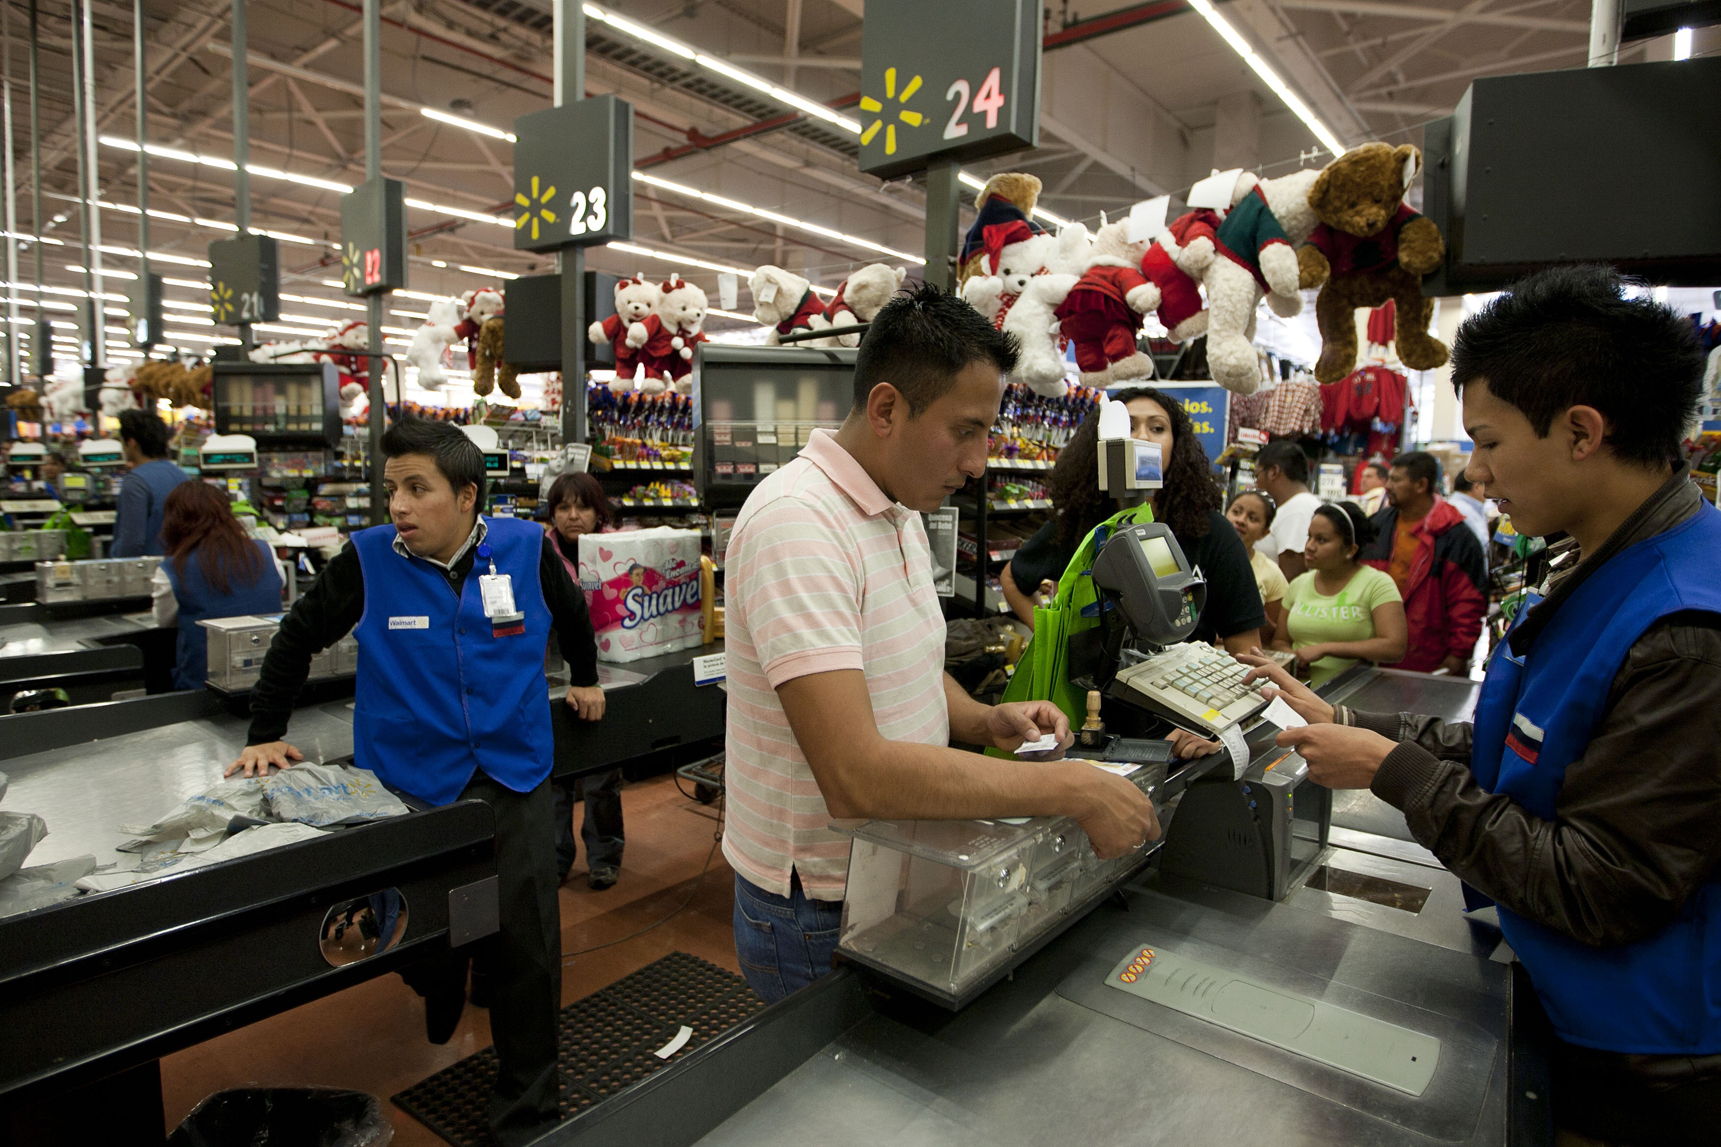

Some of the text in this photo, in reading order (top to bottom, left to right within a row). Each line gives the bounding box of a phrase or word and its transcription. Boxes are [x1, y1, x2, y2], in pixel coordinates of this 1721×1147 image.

[943, 67, 1005, 140] 24
[569, 186, 607, 235] 23
[1180, 398, 1213, 415] ios.
[1189, 418, 1215, 434] as.
[1293, 602, 1363, 620] LLISTER
[389, 619, 417, 627] Walmart
